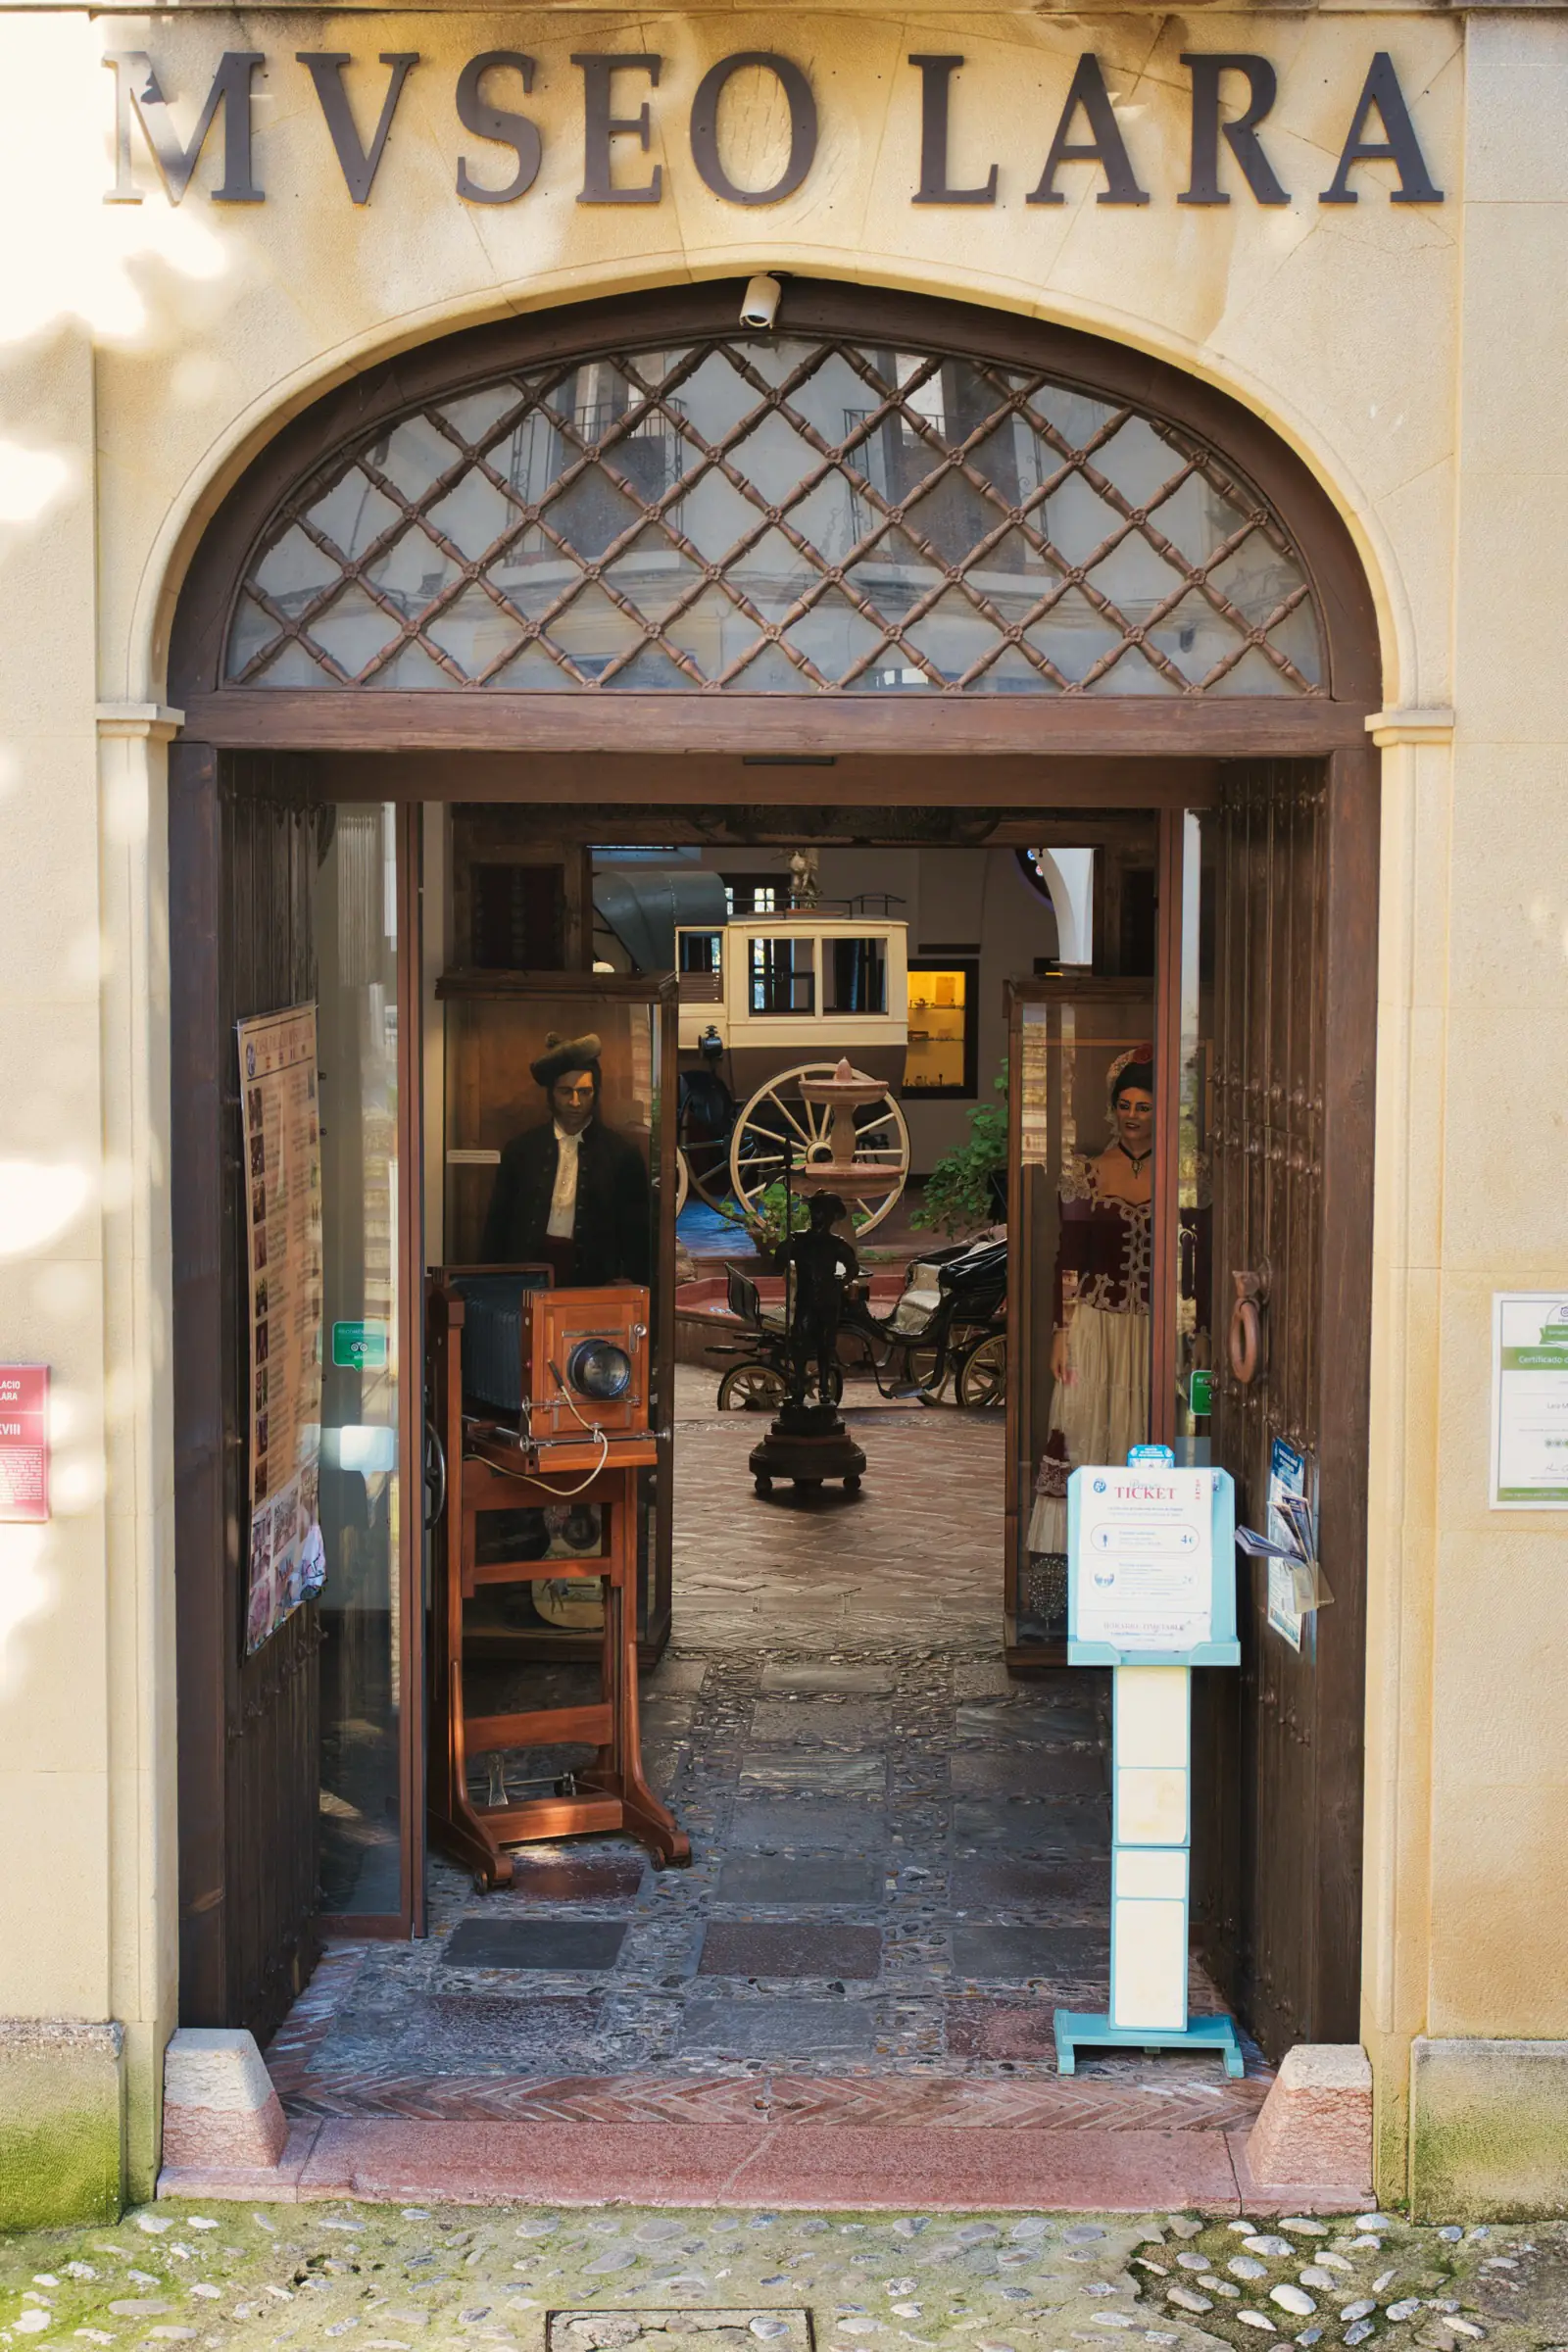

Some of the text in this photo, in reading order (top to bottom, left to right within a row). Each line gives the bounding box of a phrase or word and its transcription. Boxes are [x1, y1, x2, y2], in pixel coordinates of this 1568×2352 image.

[907, 52, 1445, 206] LARA
[1518, 1355, 1563, 1364] Certificado
[0, 1380, 21, 1390] ACIO
[0, 1392, 18, 1400] ARA
[1115, 1487, 1177, 1499] TICKET
